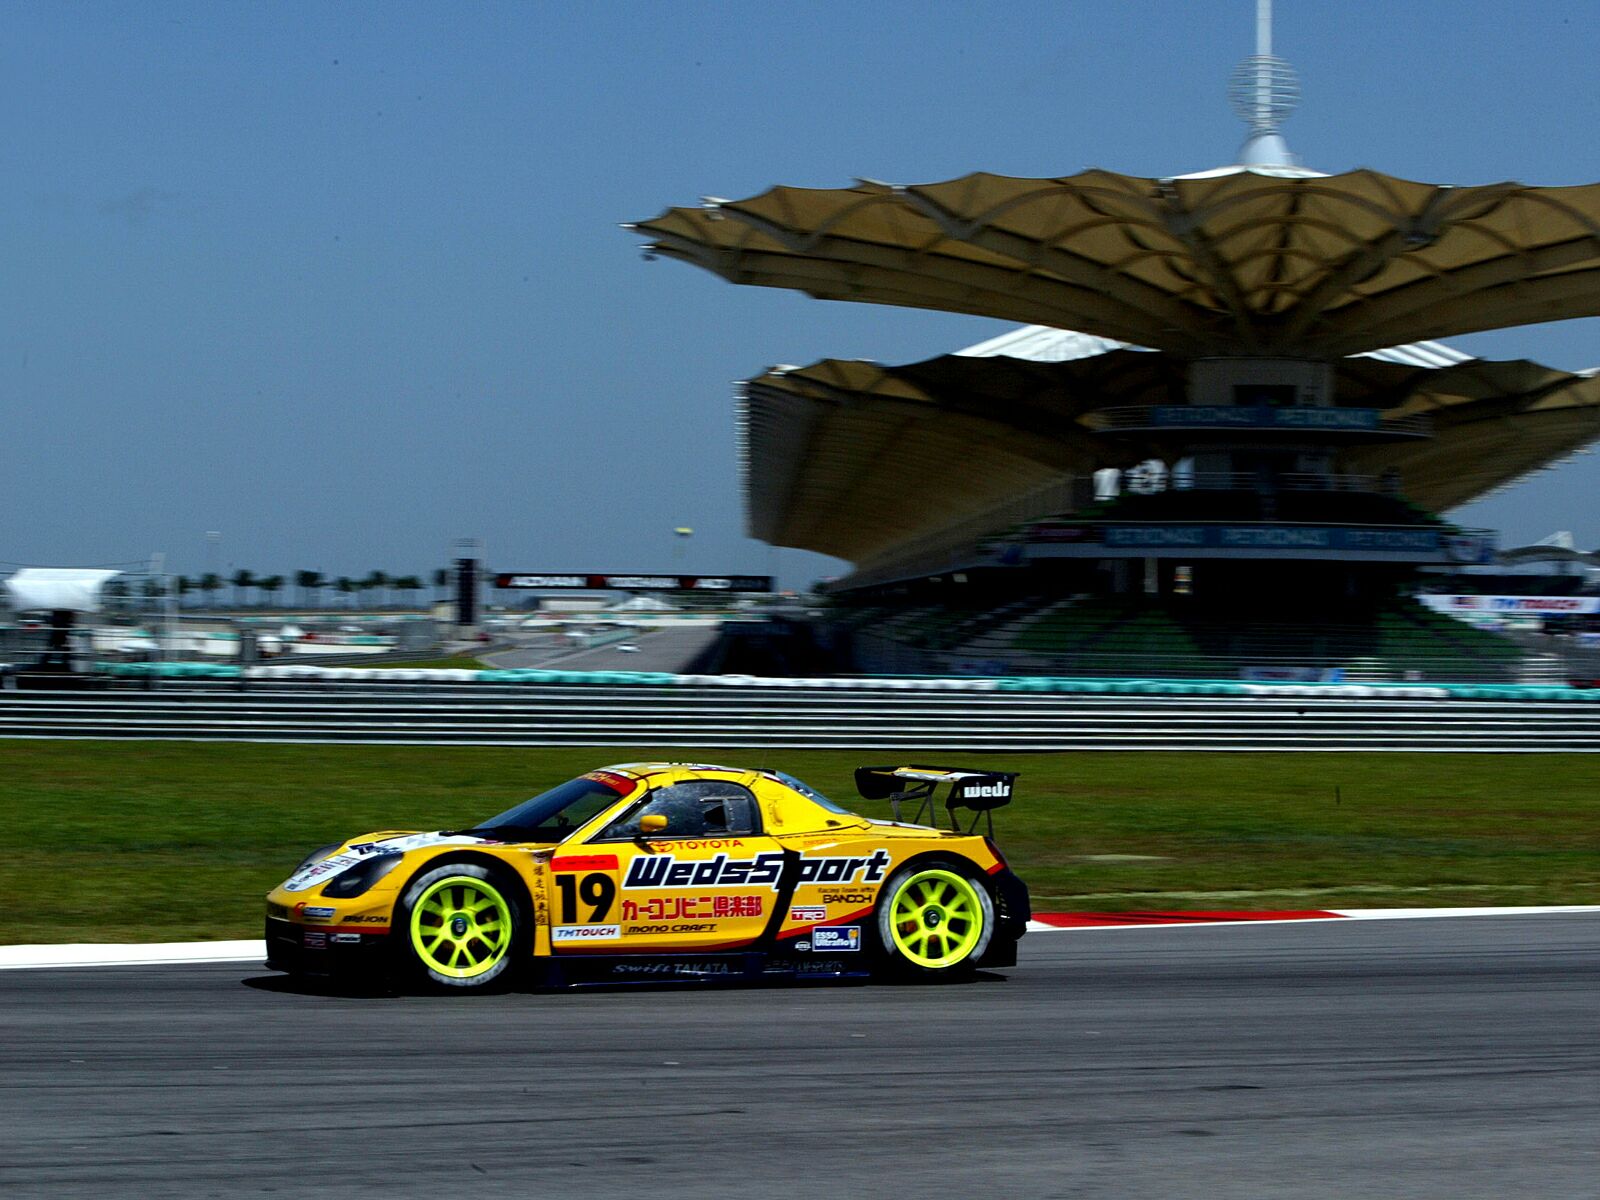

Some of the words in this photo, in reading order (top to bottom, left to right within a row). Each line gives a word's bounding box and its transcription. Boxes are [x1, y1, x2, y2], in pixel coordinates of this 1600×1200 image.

[675, 839, 744, 850] TOYOTA
[555, 872, 616, 923] 19
[823, 894, 872, 904] BANDOH
[792, 911, 826, 921] TRD
[674, 962, 729, 975] TAKATA
